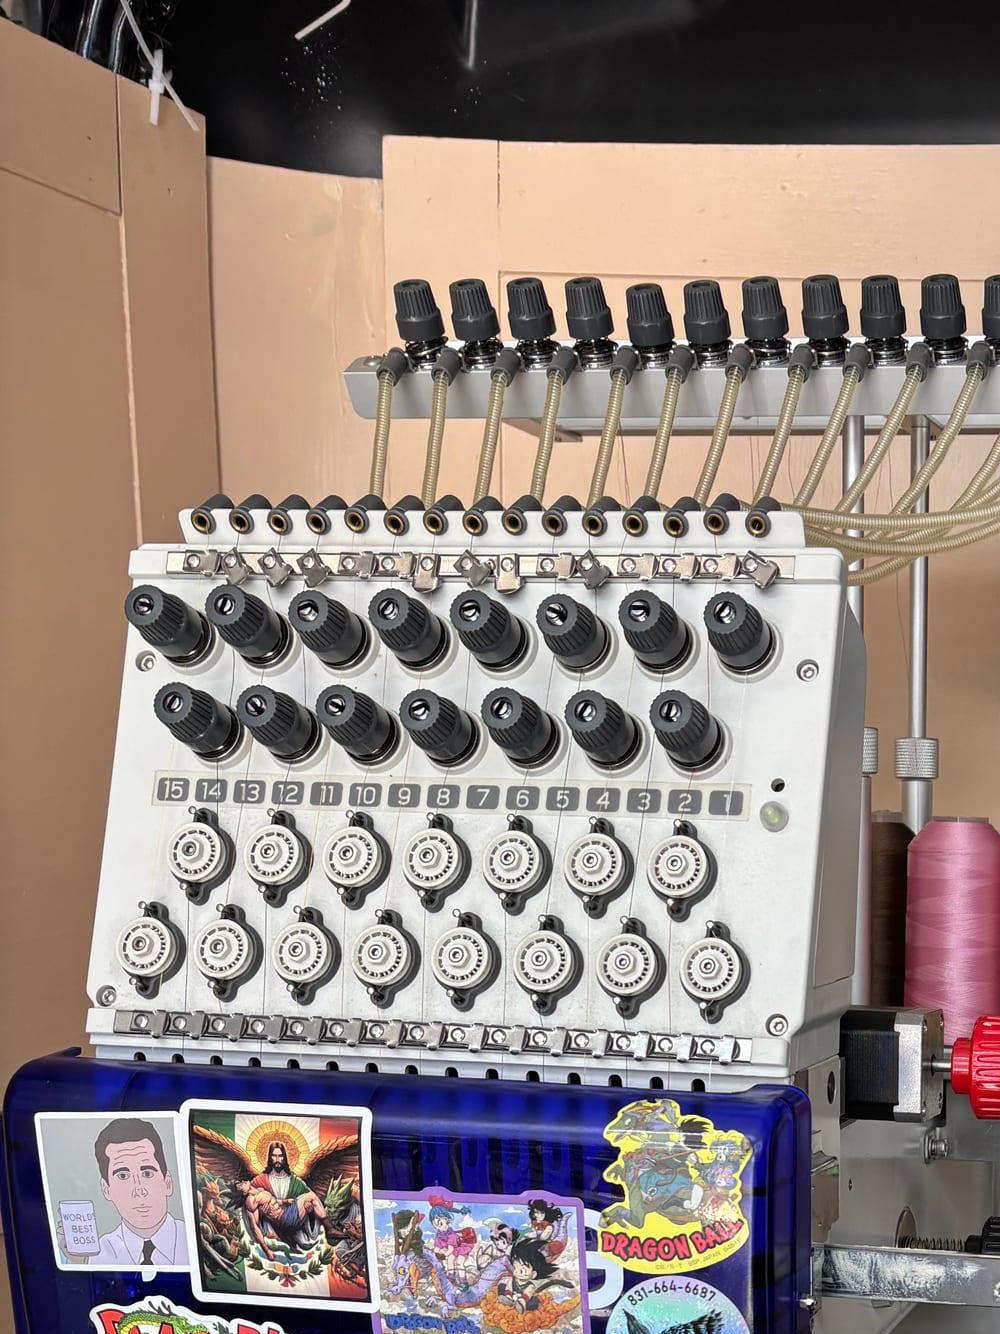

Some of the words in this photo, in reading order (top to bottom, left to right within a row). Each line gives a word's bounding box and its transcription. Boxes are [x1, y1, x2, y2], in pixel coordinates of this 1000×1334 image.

[164, 780, 184, 799] 15
[202, 781, 221, 800] 14
[240, 783, 260, 801] 13
[278, 784, 298, 802] 12
[320, 785, 334, 803] 11
[356, 786, 376, 804] 10
[398, 787, 411, 805] 9
[436, 788, 450, 805] 8
[476, 788, 490, 807] 7
[515, 789, 530, 808] 6
[556, 790, 570, 809] 5
[596, 791, 610, 810] 4
[637, 792, 651, 811] 3
[677, 793, 691, 812] 2
[72, 1225, 93, 1233] BEST
[73, 1236, 96, 1245] BOSS
[601, 1231, 692, 1261] DRAGON
[689, 1218, 744, 1254] BALL
[627, 1280, 717, 1306] 831-664-6687
